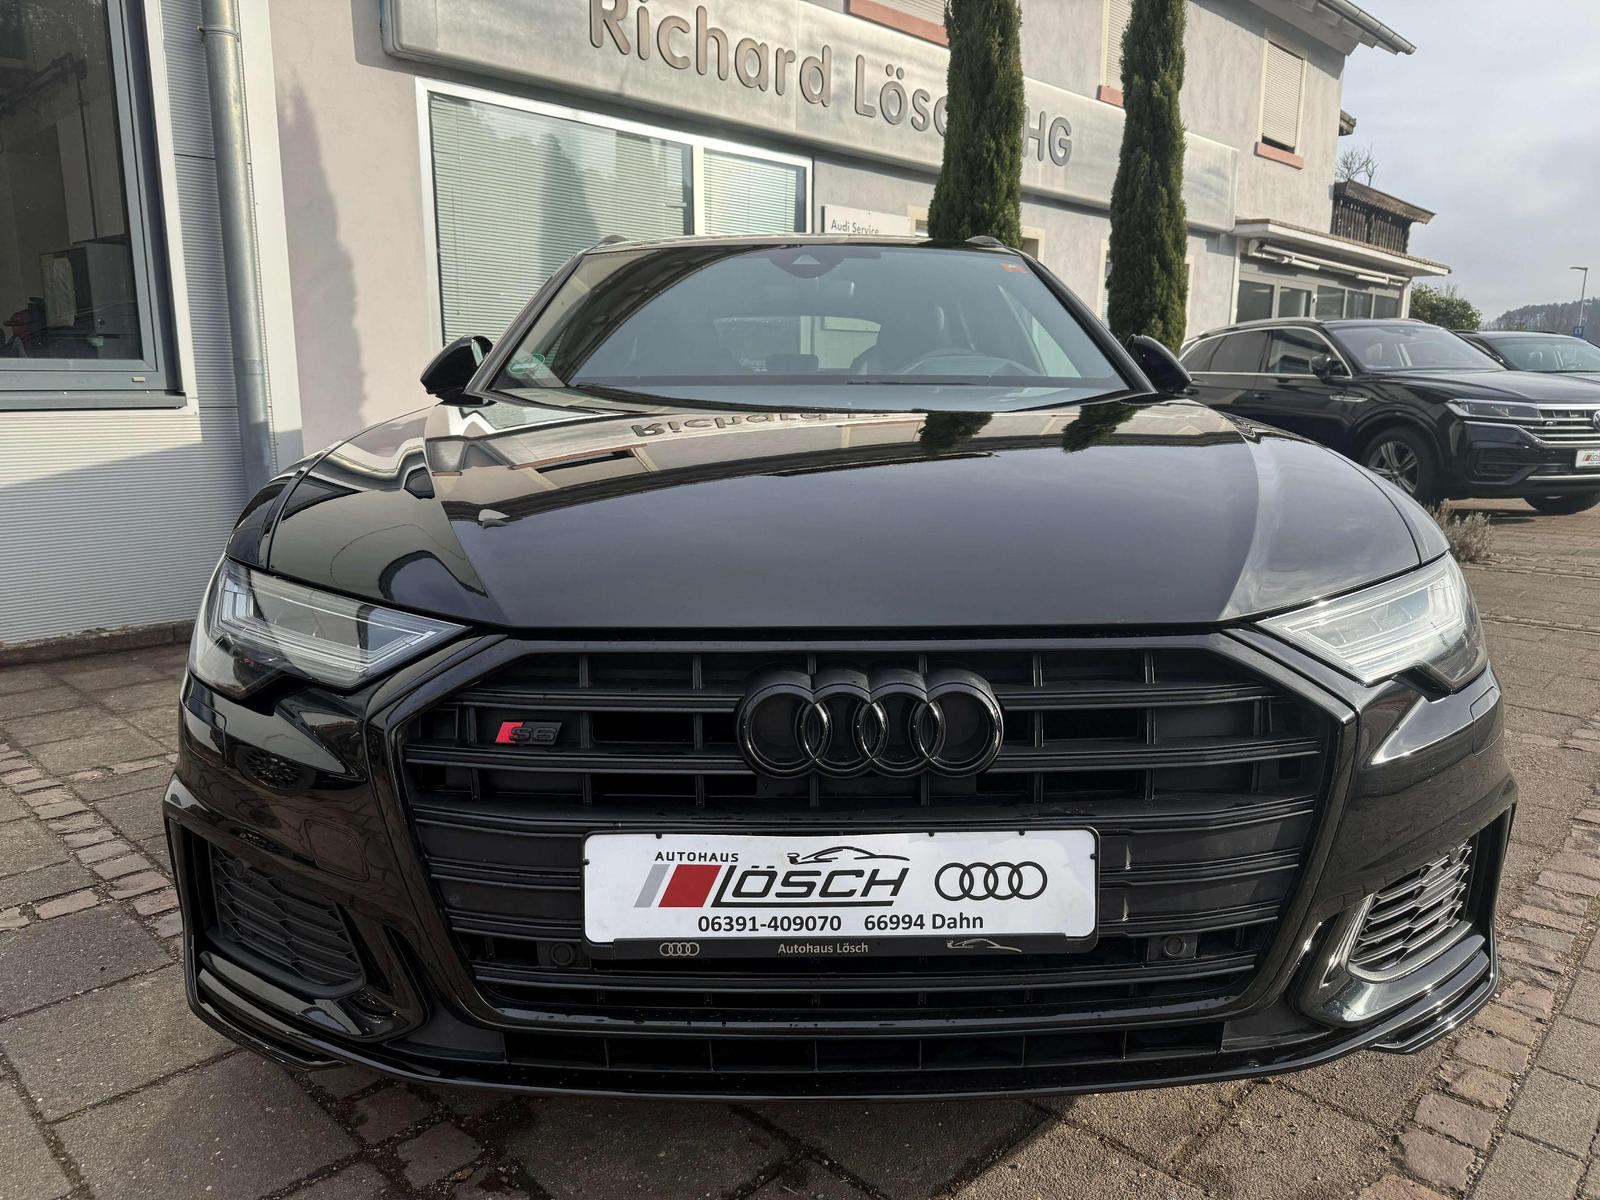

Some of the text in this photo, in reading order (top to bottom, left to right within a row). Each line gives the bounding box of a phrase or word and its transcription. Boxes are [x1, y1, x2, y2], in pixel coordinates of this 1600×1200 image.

[589, 0, 832, 108] Richard
[854, 54, 949, 138] Lösc
[831, 219, 880, 235] Audi Service
[509, 726, 557, 741] S6
[654, 851, 740, 863] AUTOHAUS
[711, 864, 909, 908] LÖSCH
[697, 911, 984, 932] 06391-409070 66994 Dahn
[777, 941, 869, 955] Autohaus Lösch
